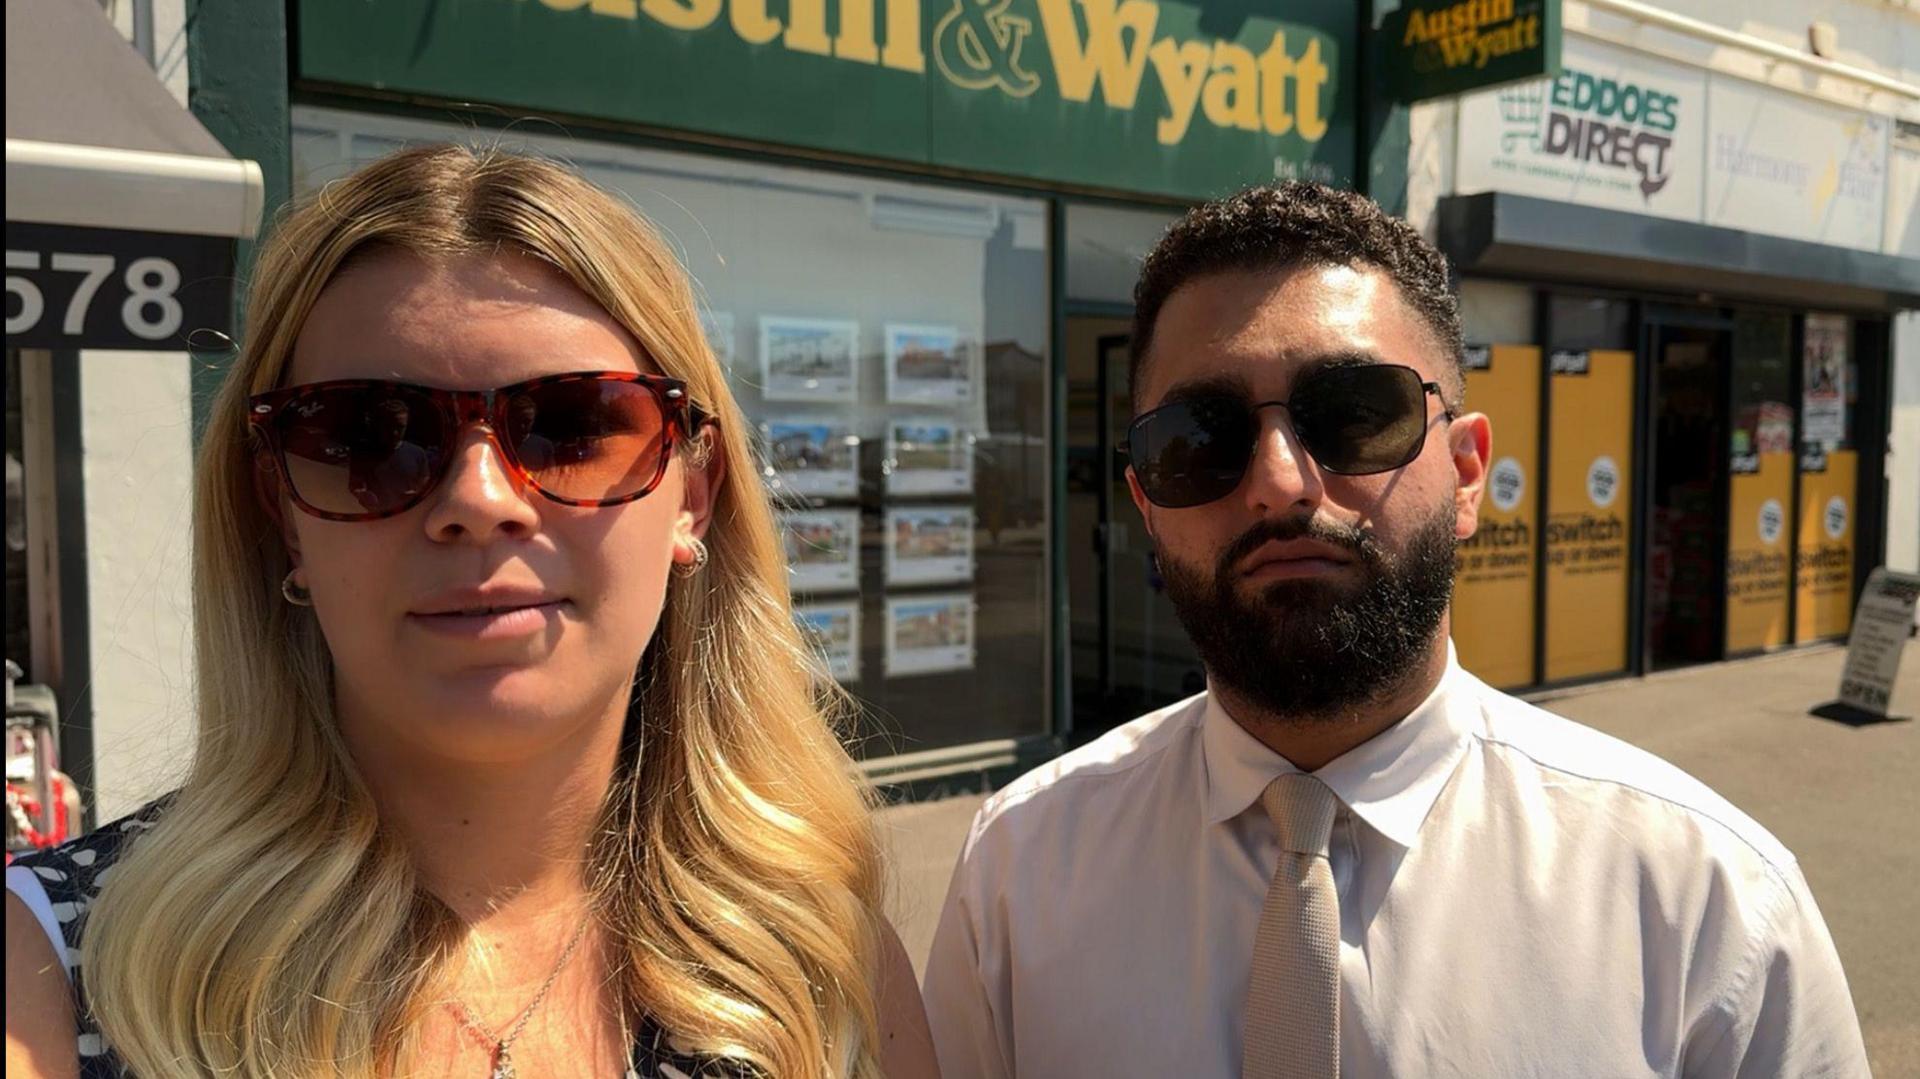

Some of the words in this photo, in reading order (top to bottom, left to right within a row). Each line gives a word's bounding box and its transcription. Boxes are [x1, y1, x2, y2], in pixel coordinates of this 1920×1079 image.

[1403, 0, 1515, 47] Austin
[1440, 14, 1539, 69] Wyatt
[1037, 0, 1329, 146] Wyatt
[1550, 69, 1680, 132] EDDOES
[1545, 112, 1672, 180] DIRECT
[6, 249, 184, 341] 578
[1547, 514, 1622, 543] switch
[1841, 678, 1889, 708] OPEN
